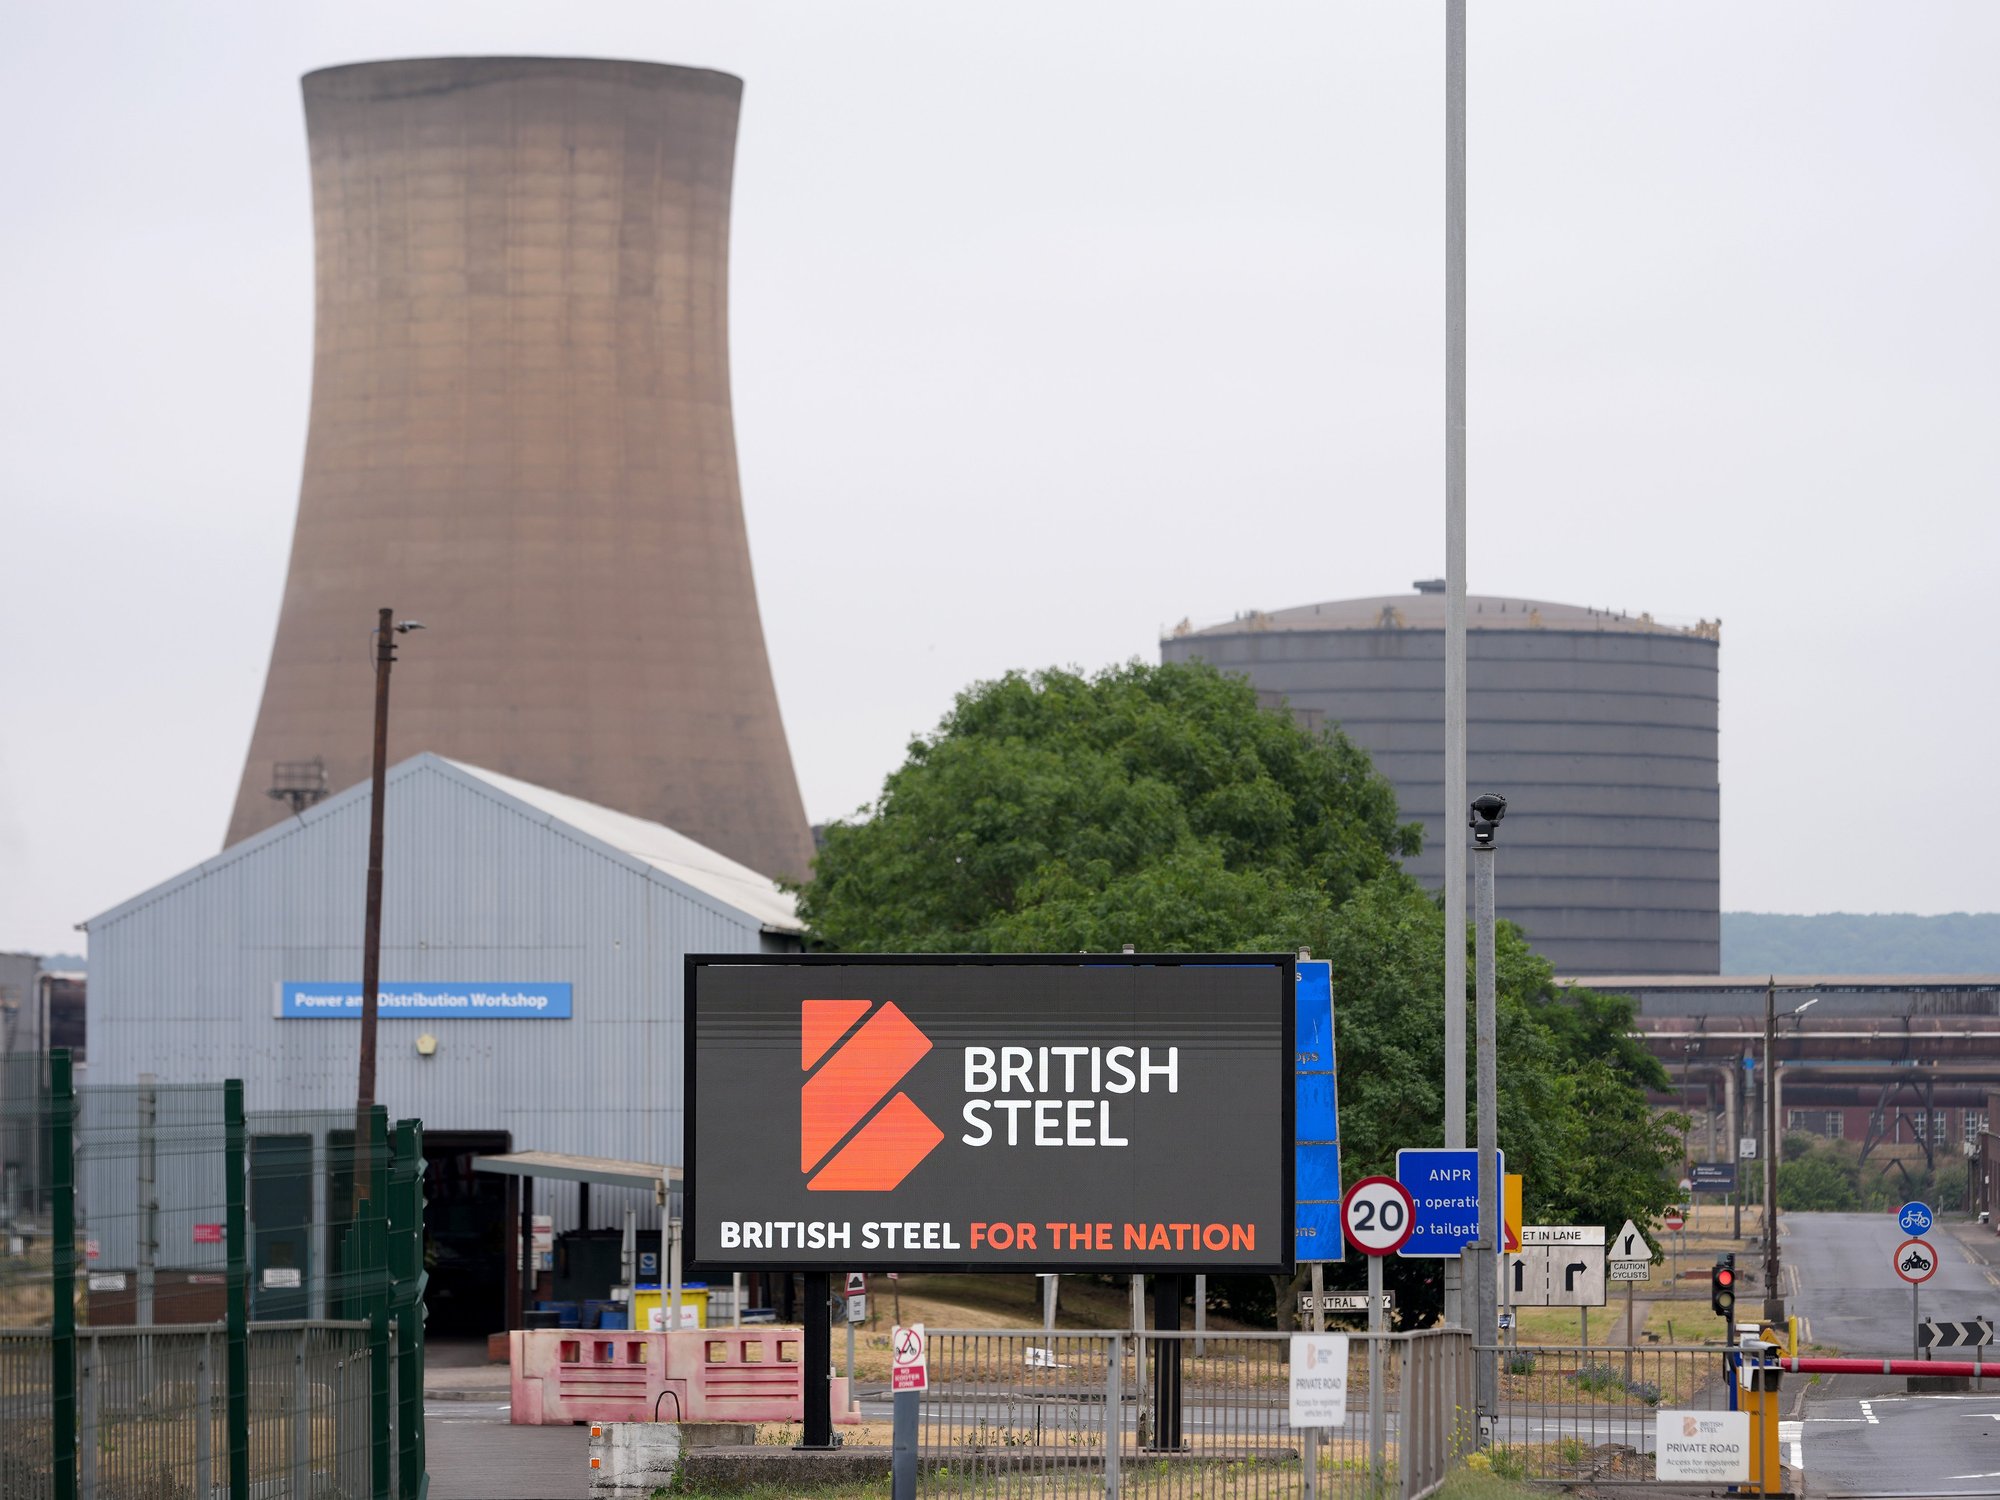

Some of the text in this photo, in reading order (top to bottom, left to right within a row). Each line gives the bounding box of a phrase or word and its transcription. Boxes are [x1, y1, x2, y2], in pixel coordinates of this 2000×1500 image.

[295, 992, 548, 1010] Power an Distribution Workshop
[964, 1046, 1178, 1093] BRITISH
[962, 1099, 1128, 1147] STEEL
[1429, 1169, 1471, 1181] ANPR
[1425, 1196, 1480, 1210] operati
[1353, 1200, 1404, 1231] 20
[720, 1221, 1256, 1251] BRITISH STEEL FOR THE NATION
[1430, 1222, 1480, 1237] tailgati
[1522, 1231, 1582, 1240] ET IN LANE
[1612, 1271, 1648, 1279] CYCLISTS
[1296, 1378, 1342, 1390] PRIVATE ROAD
[1666, 1443, 1740, 1453] PRIVATE ROAD
[1704, 1459, 1740, 1467] registered
[1710, 1467, 1727, 1476] only
